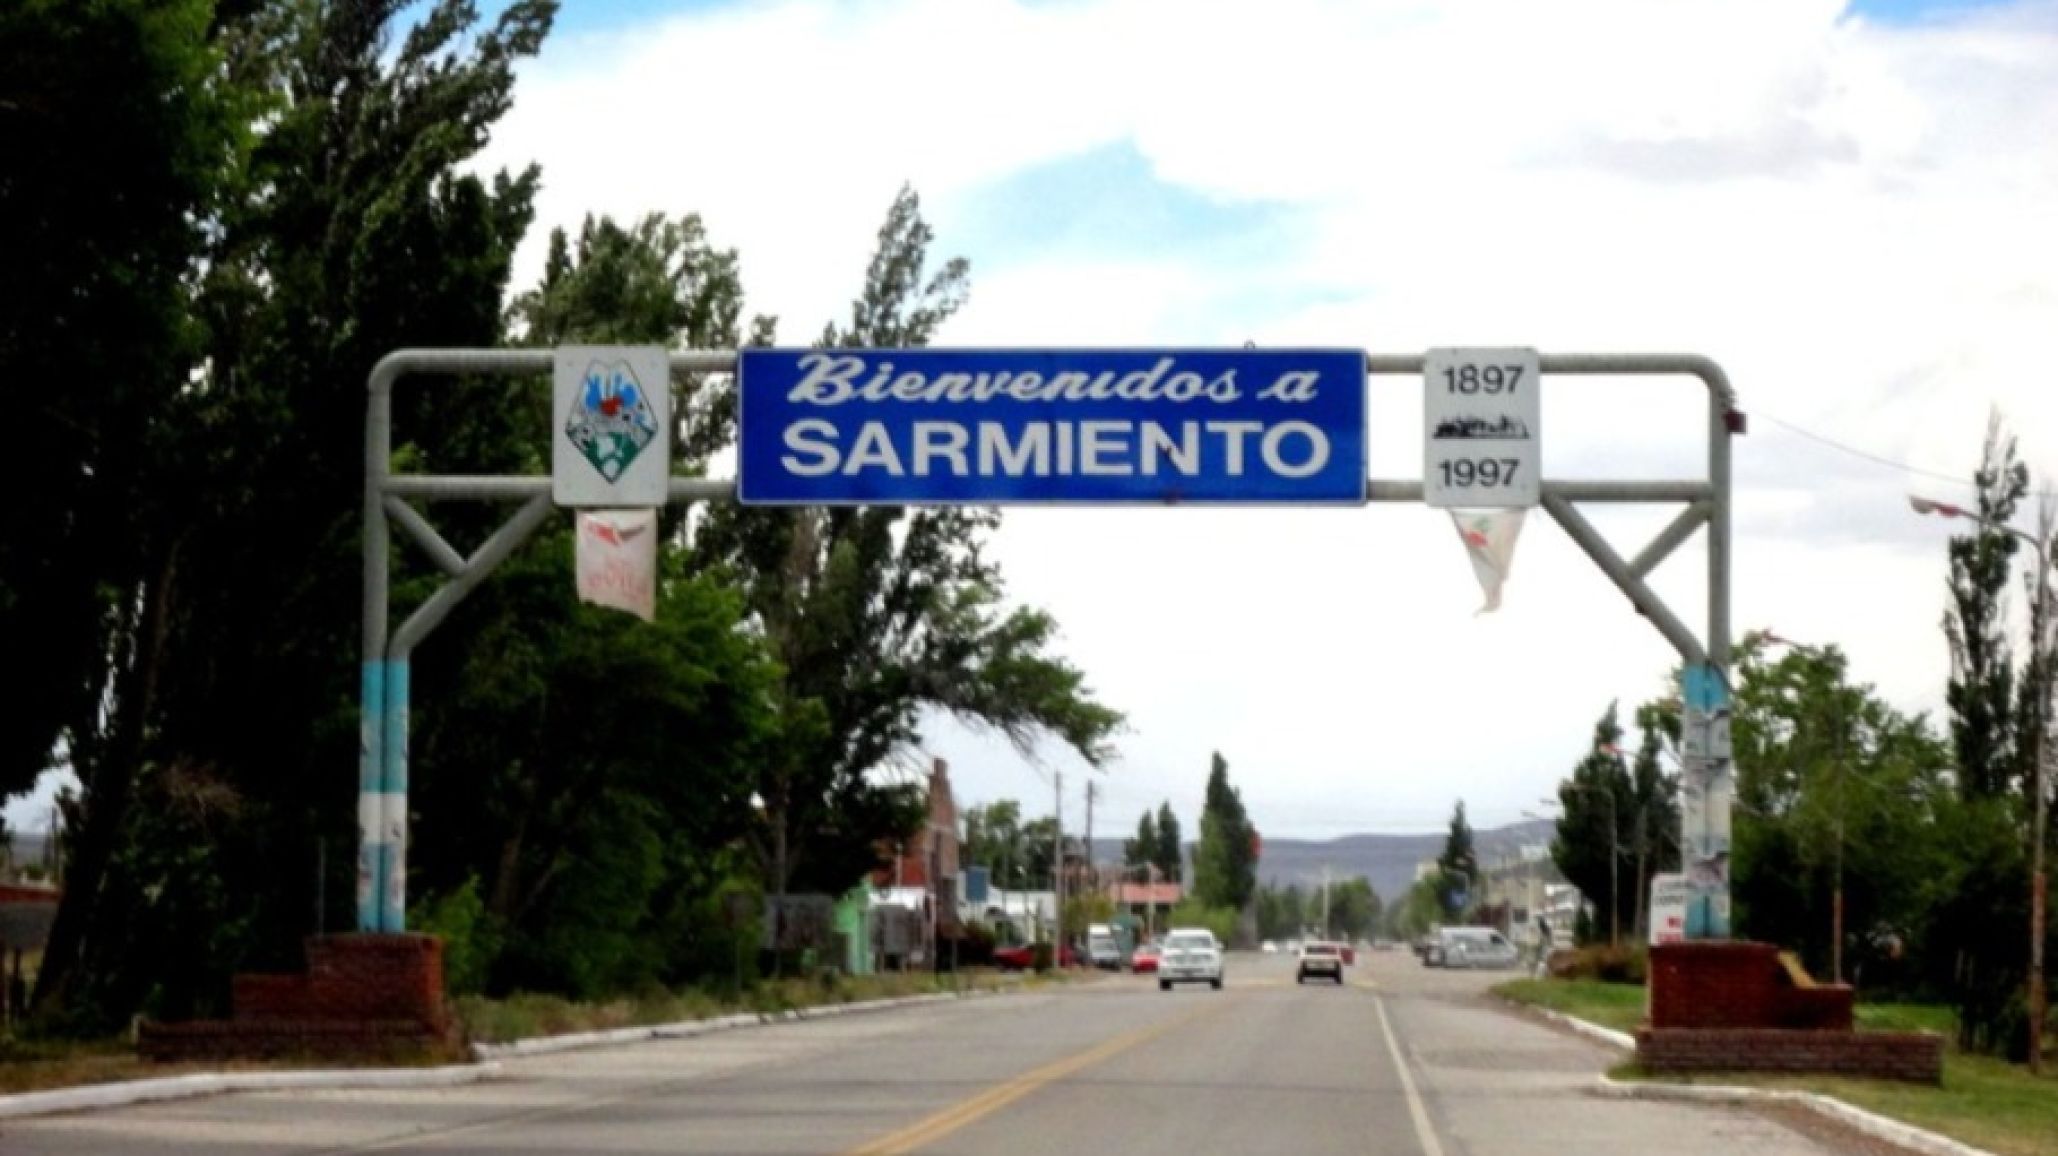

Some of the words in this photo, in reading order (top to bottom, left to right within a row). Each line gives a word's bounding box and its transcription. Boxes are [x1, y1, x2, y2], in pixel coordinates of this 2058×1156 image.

[787, 353, 1243, 406] Bienvenidos
[1257, 371, 1319, 401] a
[1441, 364, 1524, 394] 1897
[780, 418, 1332, 478] SARMIENTO
[1438, 457, 1521, 487] 1997
